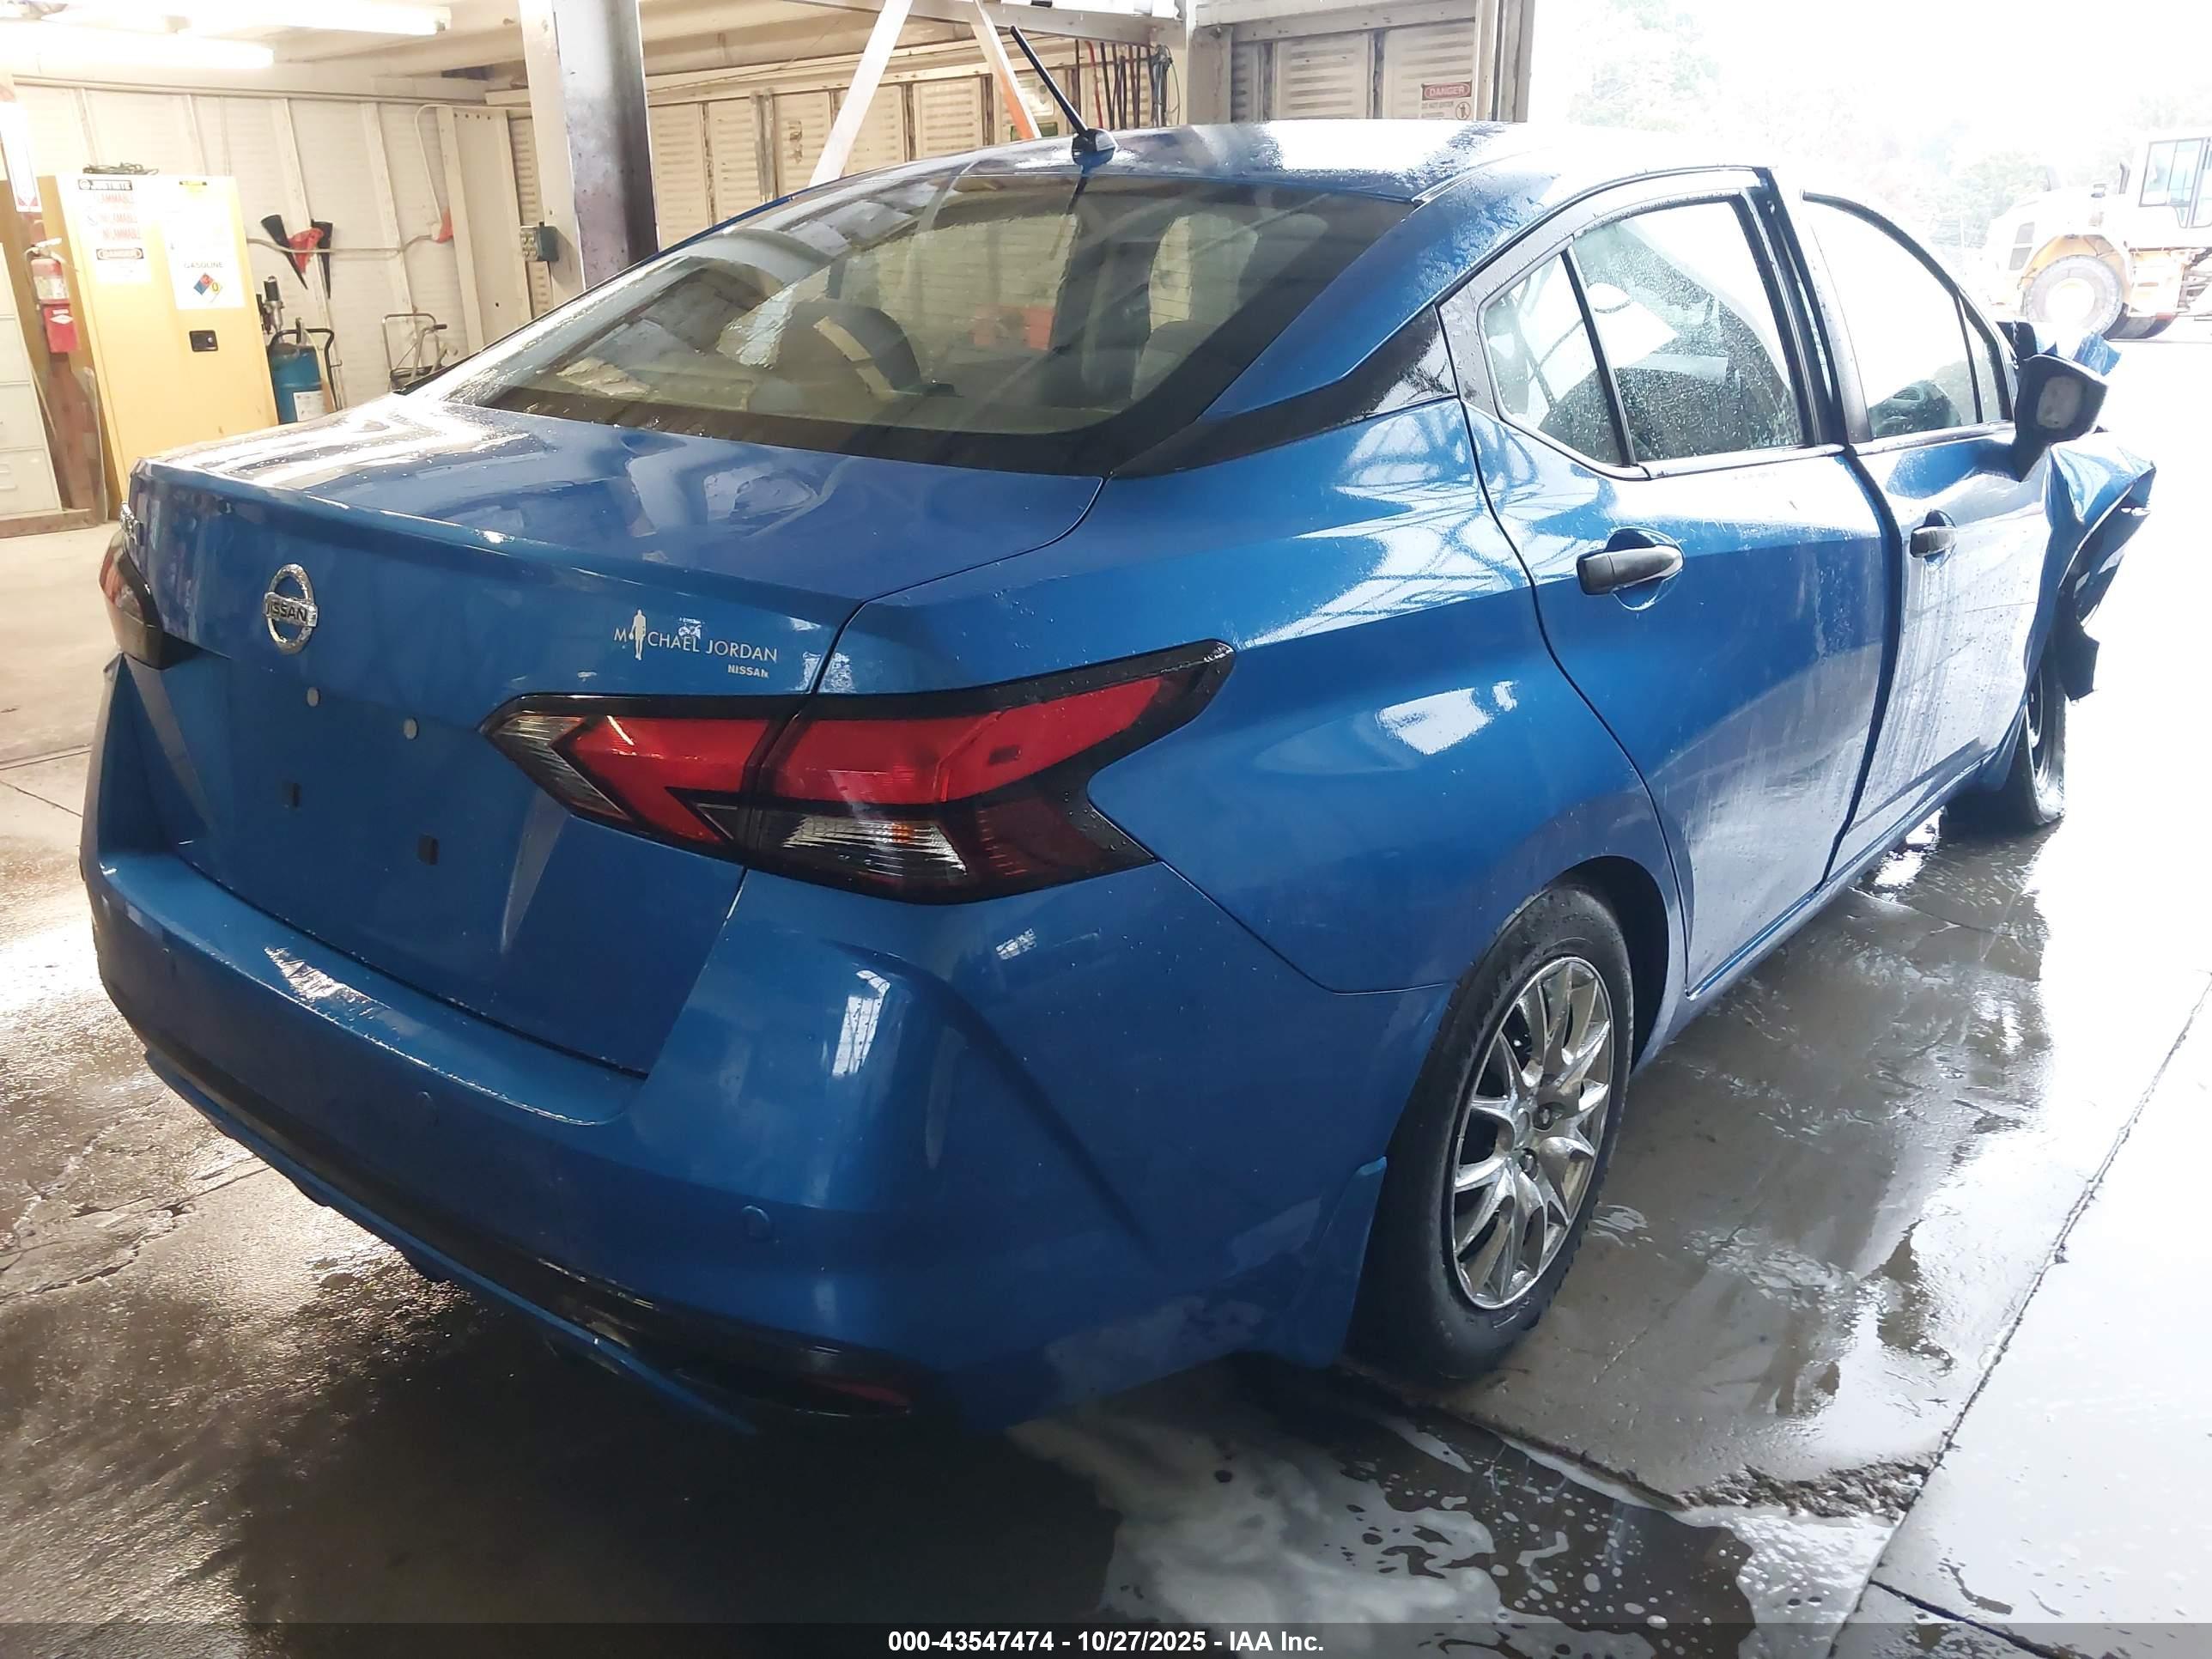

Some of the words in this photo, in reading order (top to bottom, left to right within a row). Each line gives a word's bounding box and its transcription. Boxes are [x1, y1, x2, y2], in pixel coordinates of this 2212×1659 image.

[1429, 86, 1465, 97] DANGER
[705, 639, 778, 663] JORDAN
[727, 664, 769, 679] NISSAN
